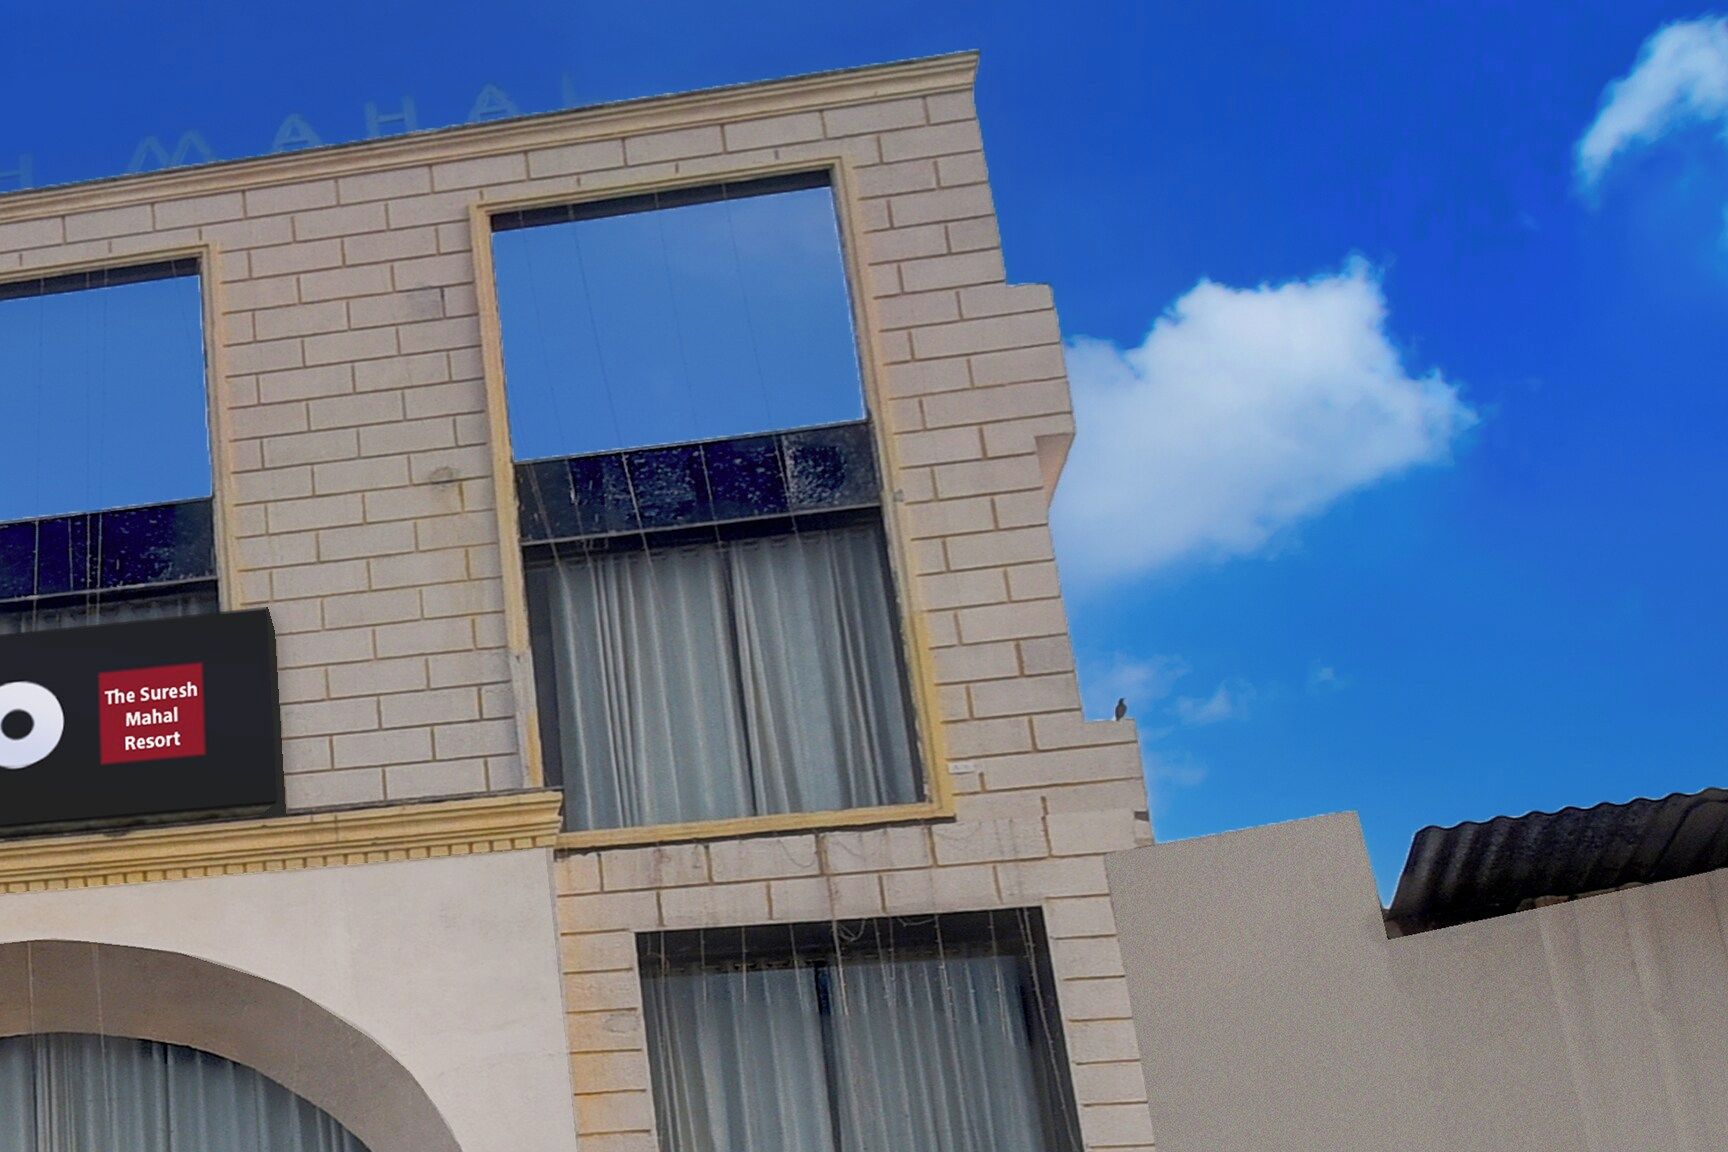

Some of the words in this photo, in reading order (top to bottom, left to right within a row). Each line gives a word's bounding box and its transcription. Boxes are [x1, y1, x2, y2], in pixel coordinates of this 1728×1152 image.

[104, 688, 135, 705] The
[140, 681, 198, 702] Suresh
[125, 706, 179, 727] Mahal
[124, 731, 181, 751] Resort
